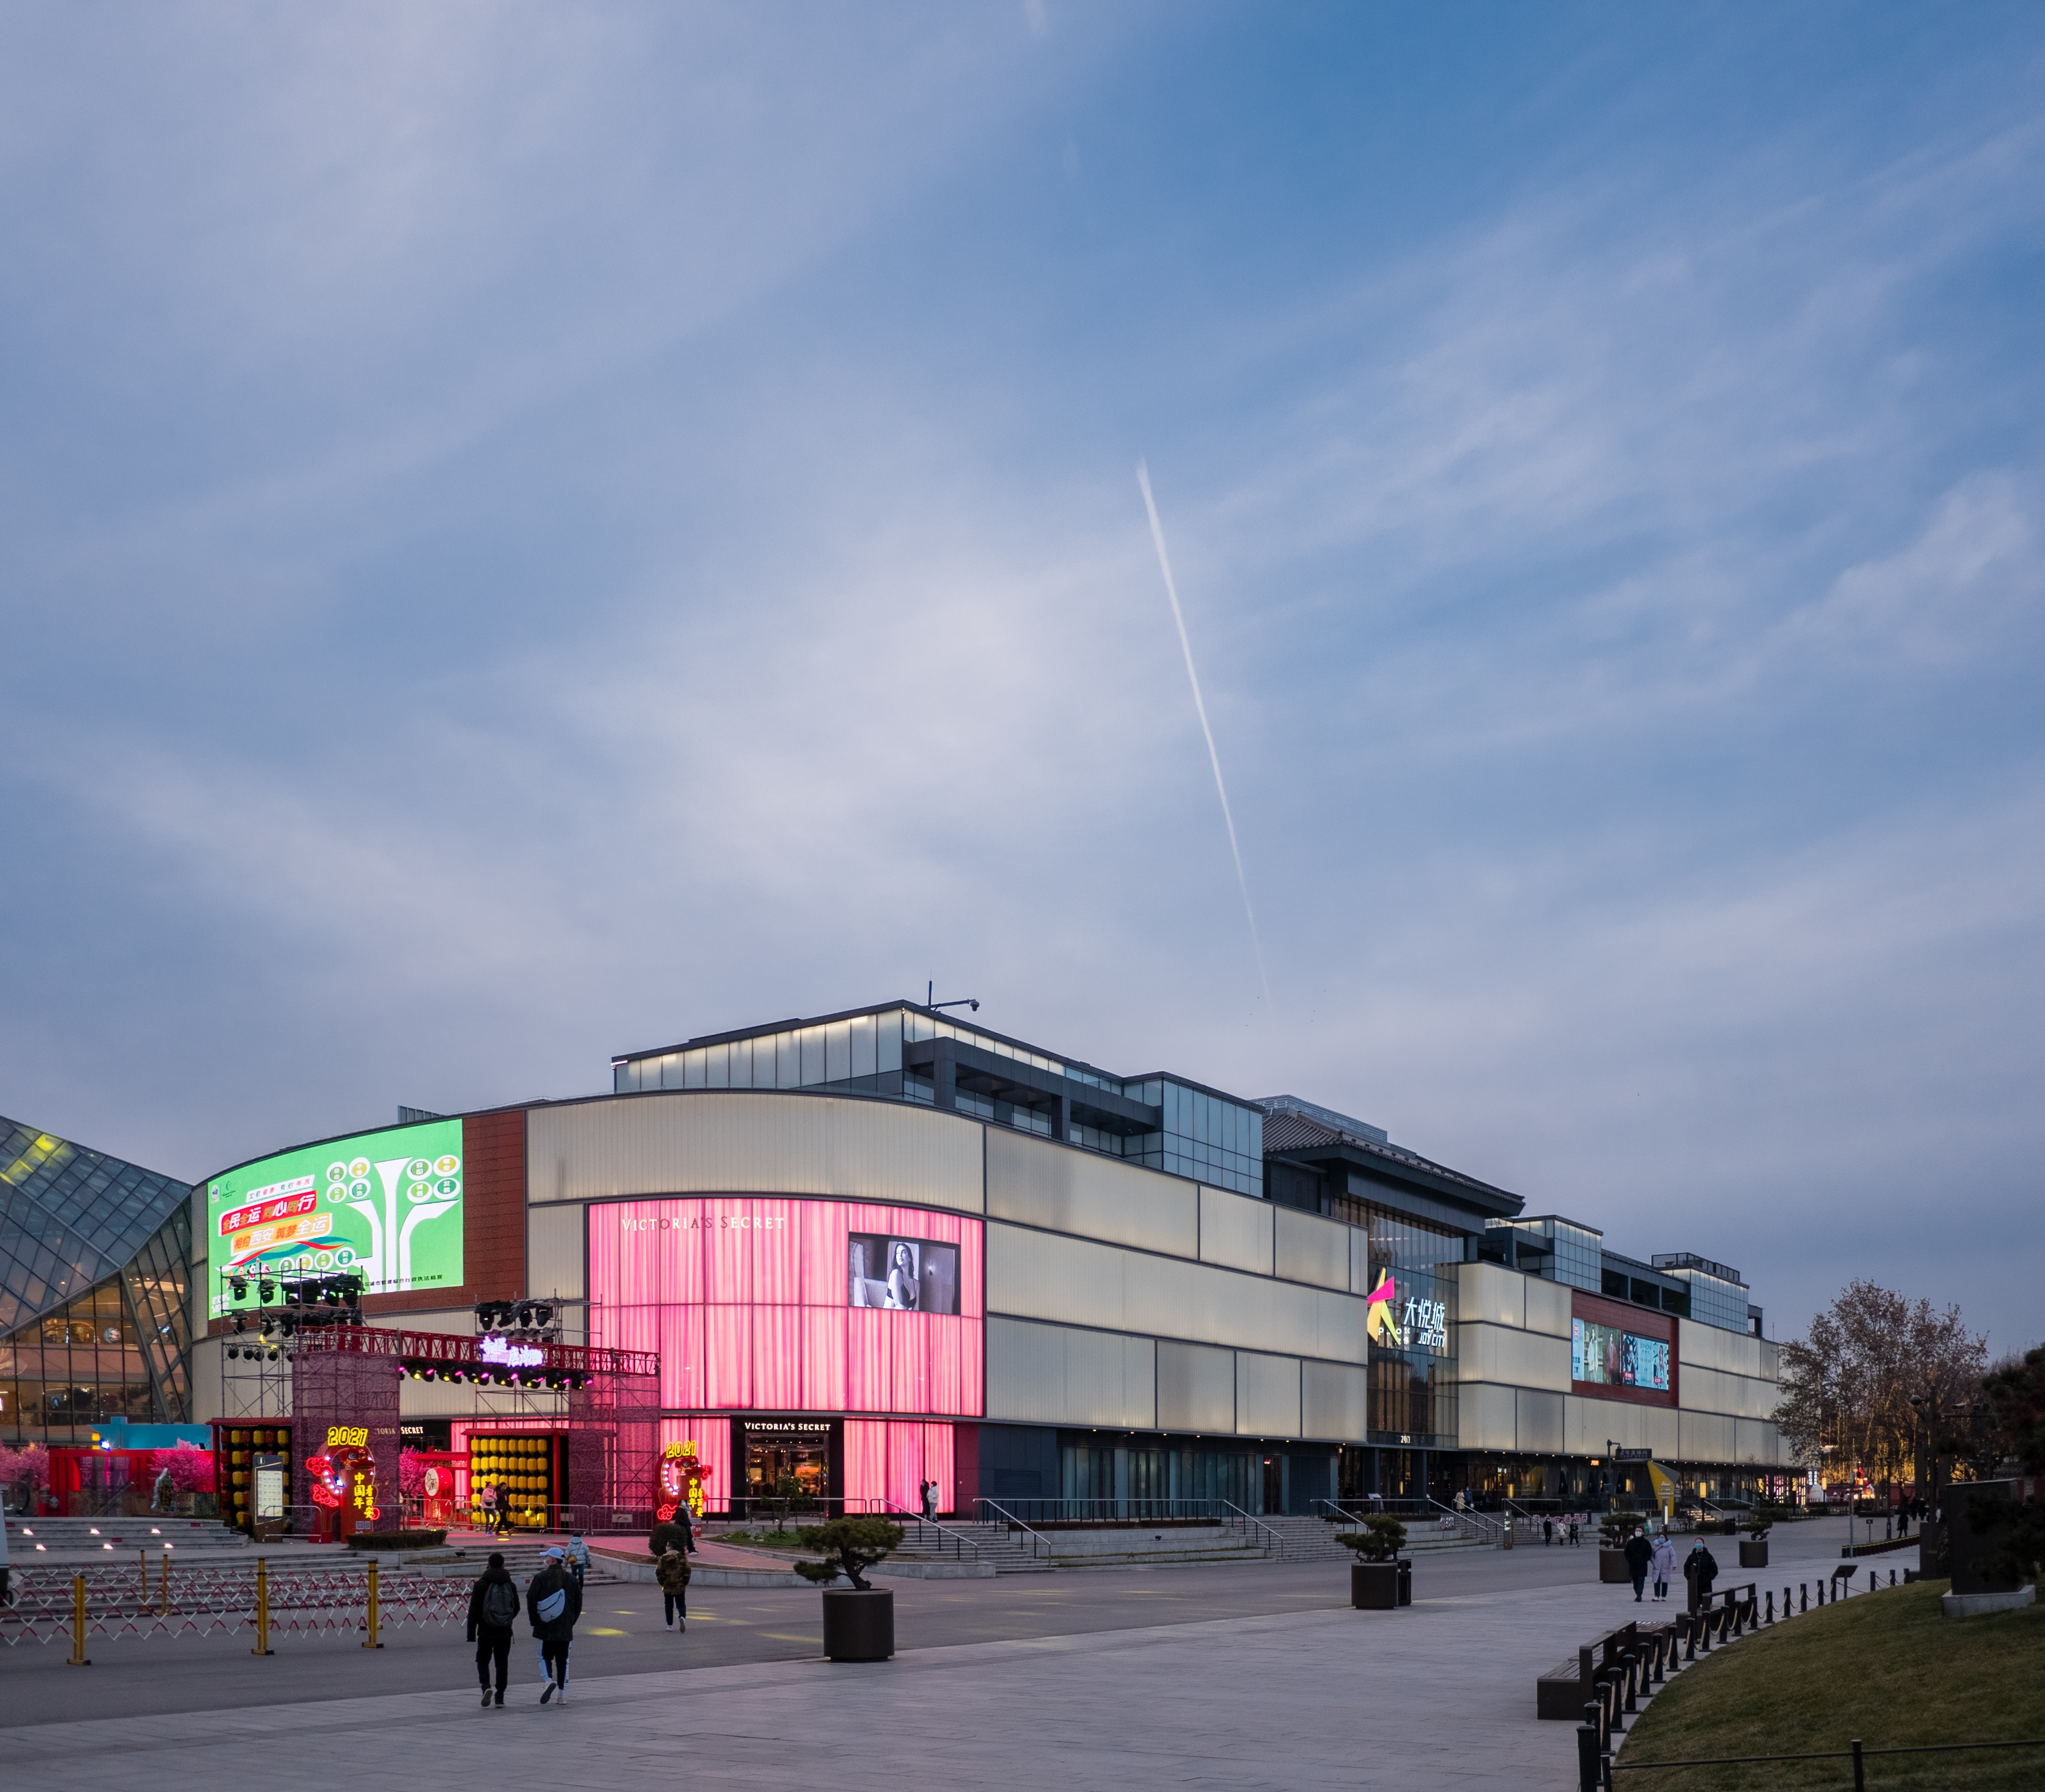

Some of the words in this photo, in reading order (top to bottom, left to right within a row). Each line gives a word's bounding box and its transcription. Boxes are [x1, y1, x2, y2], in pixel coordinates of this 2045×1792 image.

[223, 1207, 262, 1230] 全民全运
[263, 1194, 315, 1218] 同心同行
[622, 1217, 712, 1231] VICTORIA'S
[721, 1216, 784, 1229] SECRET
[234, 1227, 275, 1249] 相约西安
[275, 1216, 328, 1239] 筑梦全运
[1403, 1296, 1445, 1332] 大悦城
[1418, 1332, 1432, 1345] JOY
[1432, 1334, 1446, 1347] CITY
[327, 1426, 368, 1447] 2021
[666, 1440, 697, 1458] 2021
[353, 1472, 365, 1509] 中国年
[364, 1485, 374, 1519] 看西安
[688, 1477, 698, 1508] 中国年
[695, 1488, 704, 1517] 看西安
